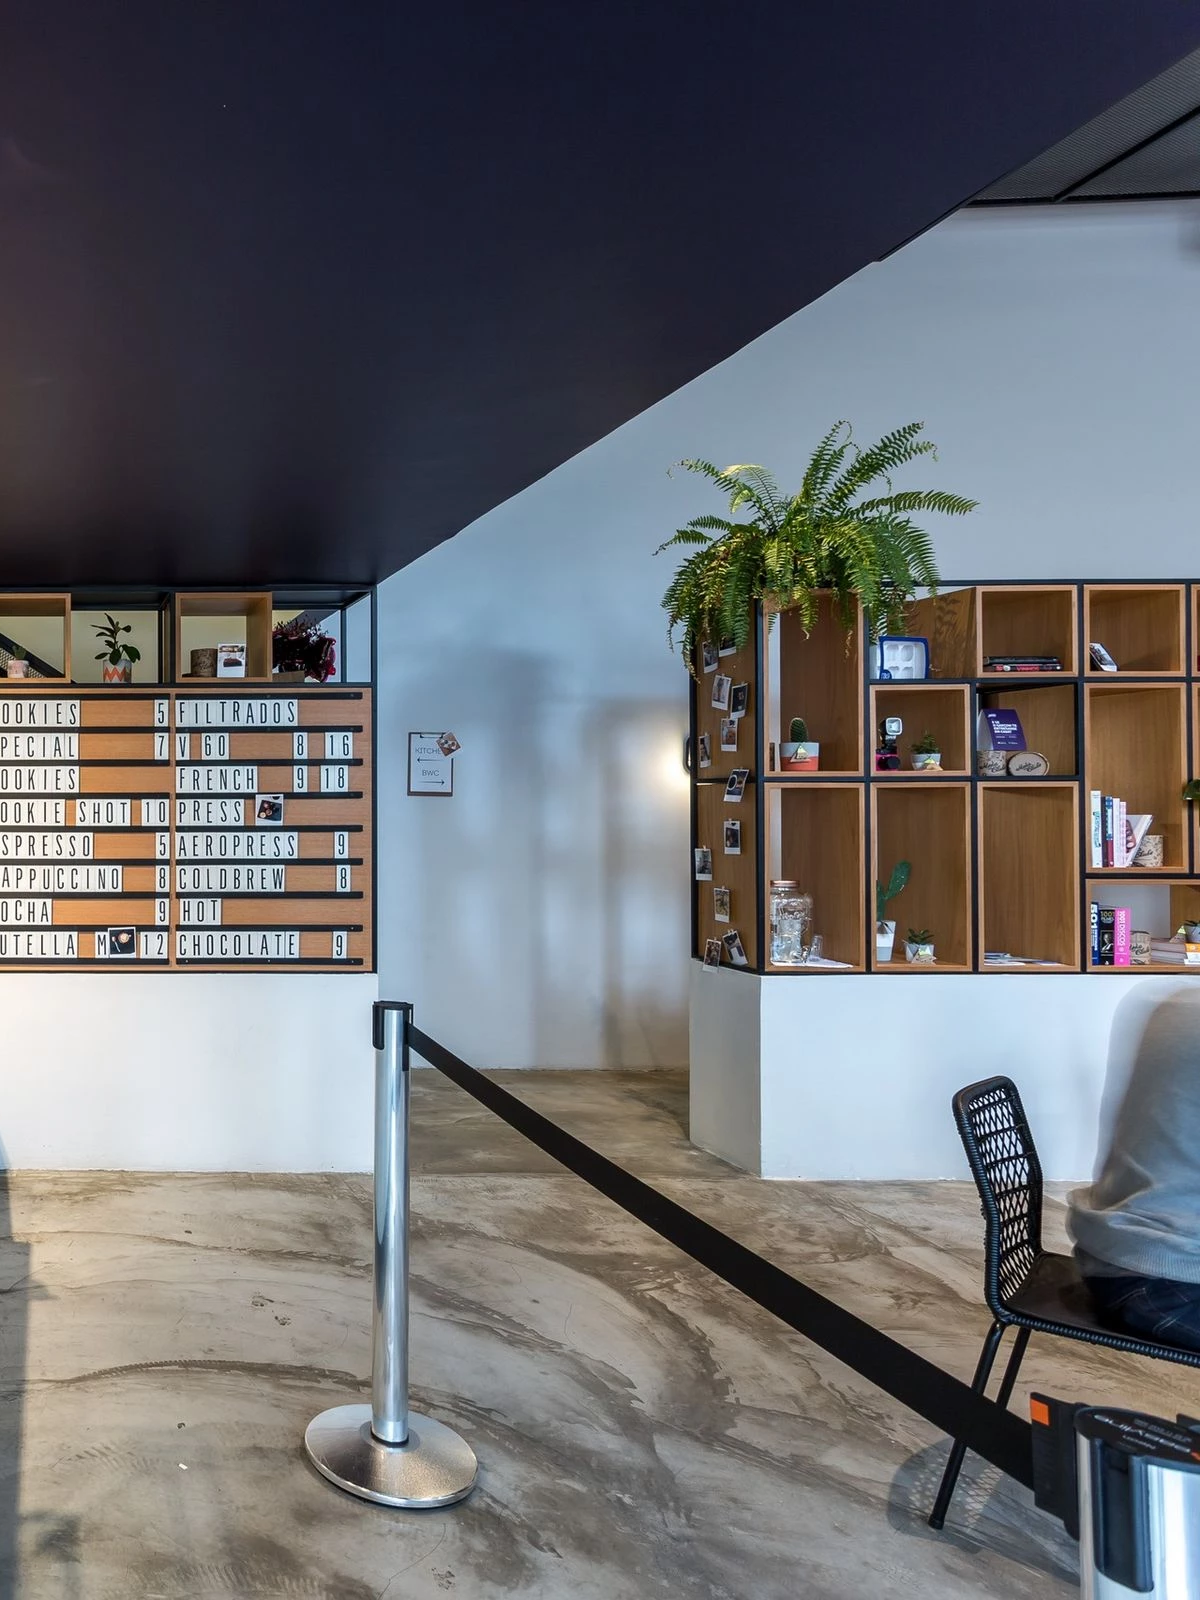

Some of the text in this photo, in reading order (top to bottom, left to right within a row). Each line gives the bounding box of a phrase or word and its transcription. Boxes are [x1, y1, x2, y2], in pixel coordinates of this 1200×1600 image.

[158, 702, 165, 724] 5
[180, 702, 295, 724] FILTRADOS
[158, 736, 165, 757] 7
[180, 735, 350, 757] V 60 8 16
[415, 747, 442, 755] KITCHE
[180, 768, 345, 790] FRENCH 9 18
[79, 801, 127, 823] SHOT
[146, 801, 166, 823] 10
[179, 800, 241, 823] PRESS
[159, 834, 166, 856] 5
[179, 834, 345, 857] AEROPRESS 9
[159, 868, 166, 889] 8
[179, 868, 347, 890] COLDBREW 8
[159, 900, 166, 922] 9
[183, 900, 218, 922] HOT
[145, 934, 164, 955] 12
[180, 934, 343, 956] CHOCOLATE 9
